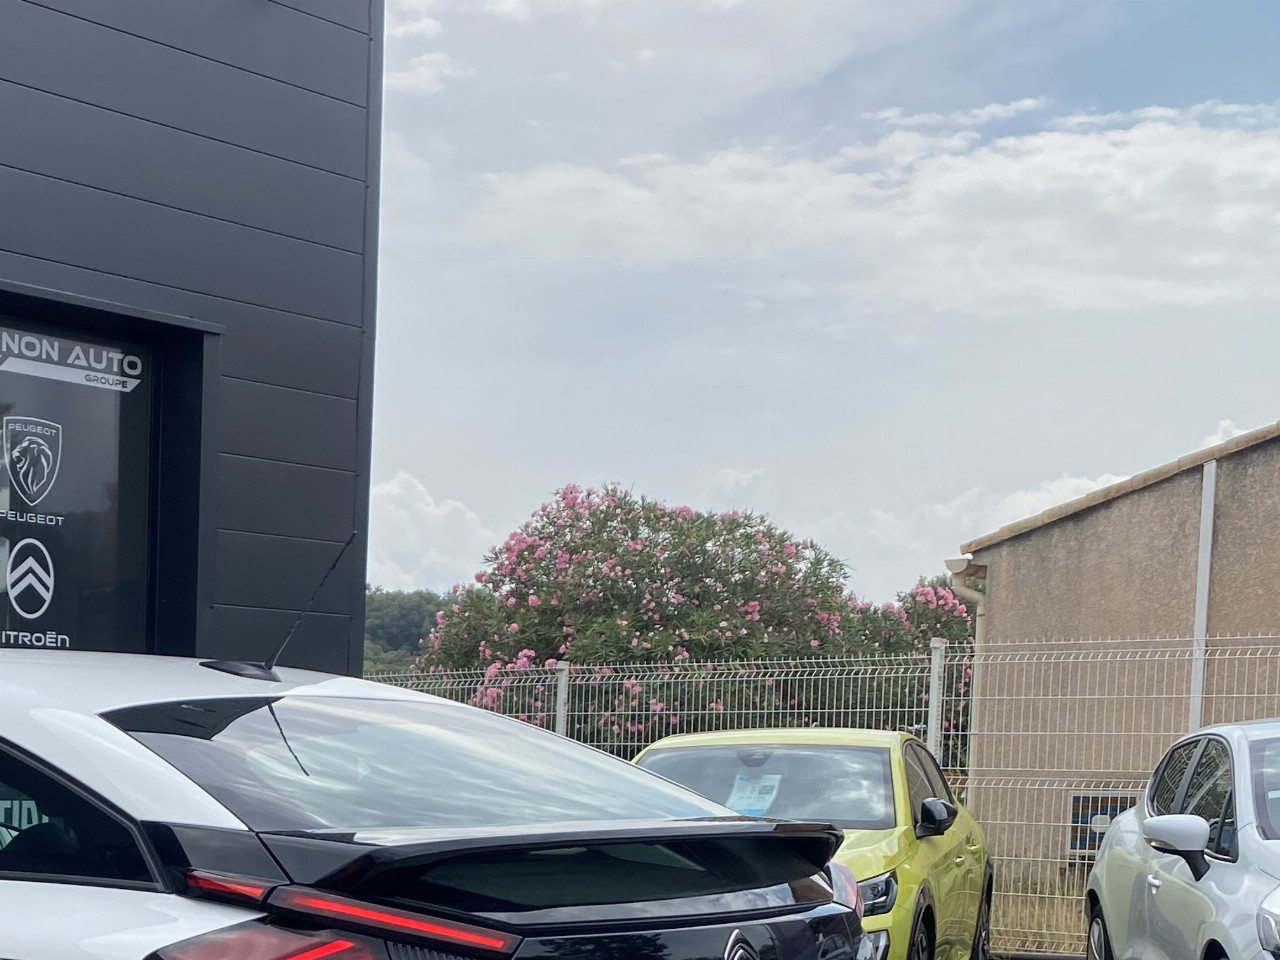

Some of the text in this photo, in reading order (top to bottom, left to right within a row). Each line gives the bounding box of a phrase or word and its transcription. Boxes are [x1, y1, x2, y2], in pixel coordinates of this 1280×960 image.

[66, 345, 142, 376] AUTO
[84, 373, 128, 389] GROUPE
[8, 422, 57, 438] PEUGEOT
